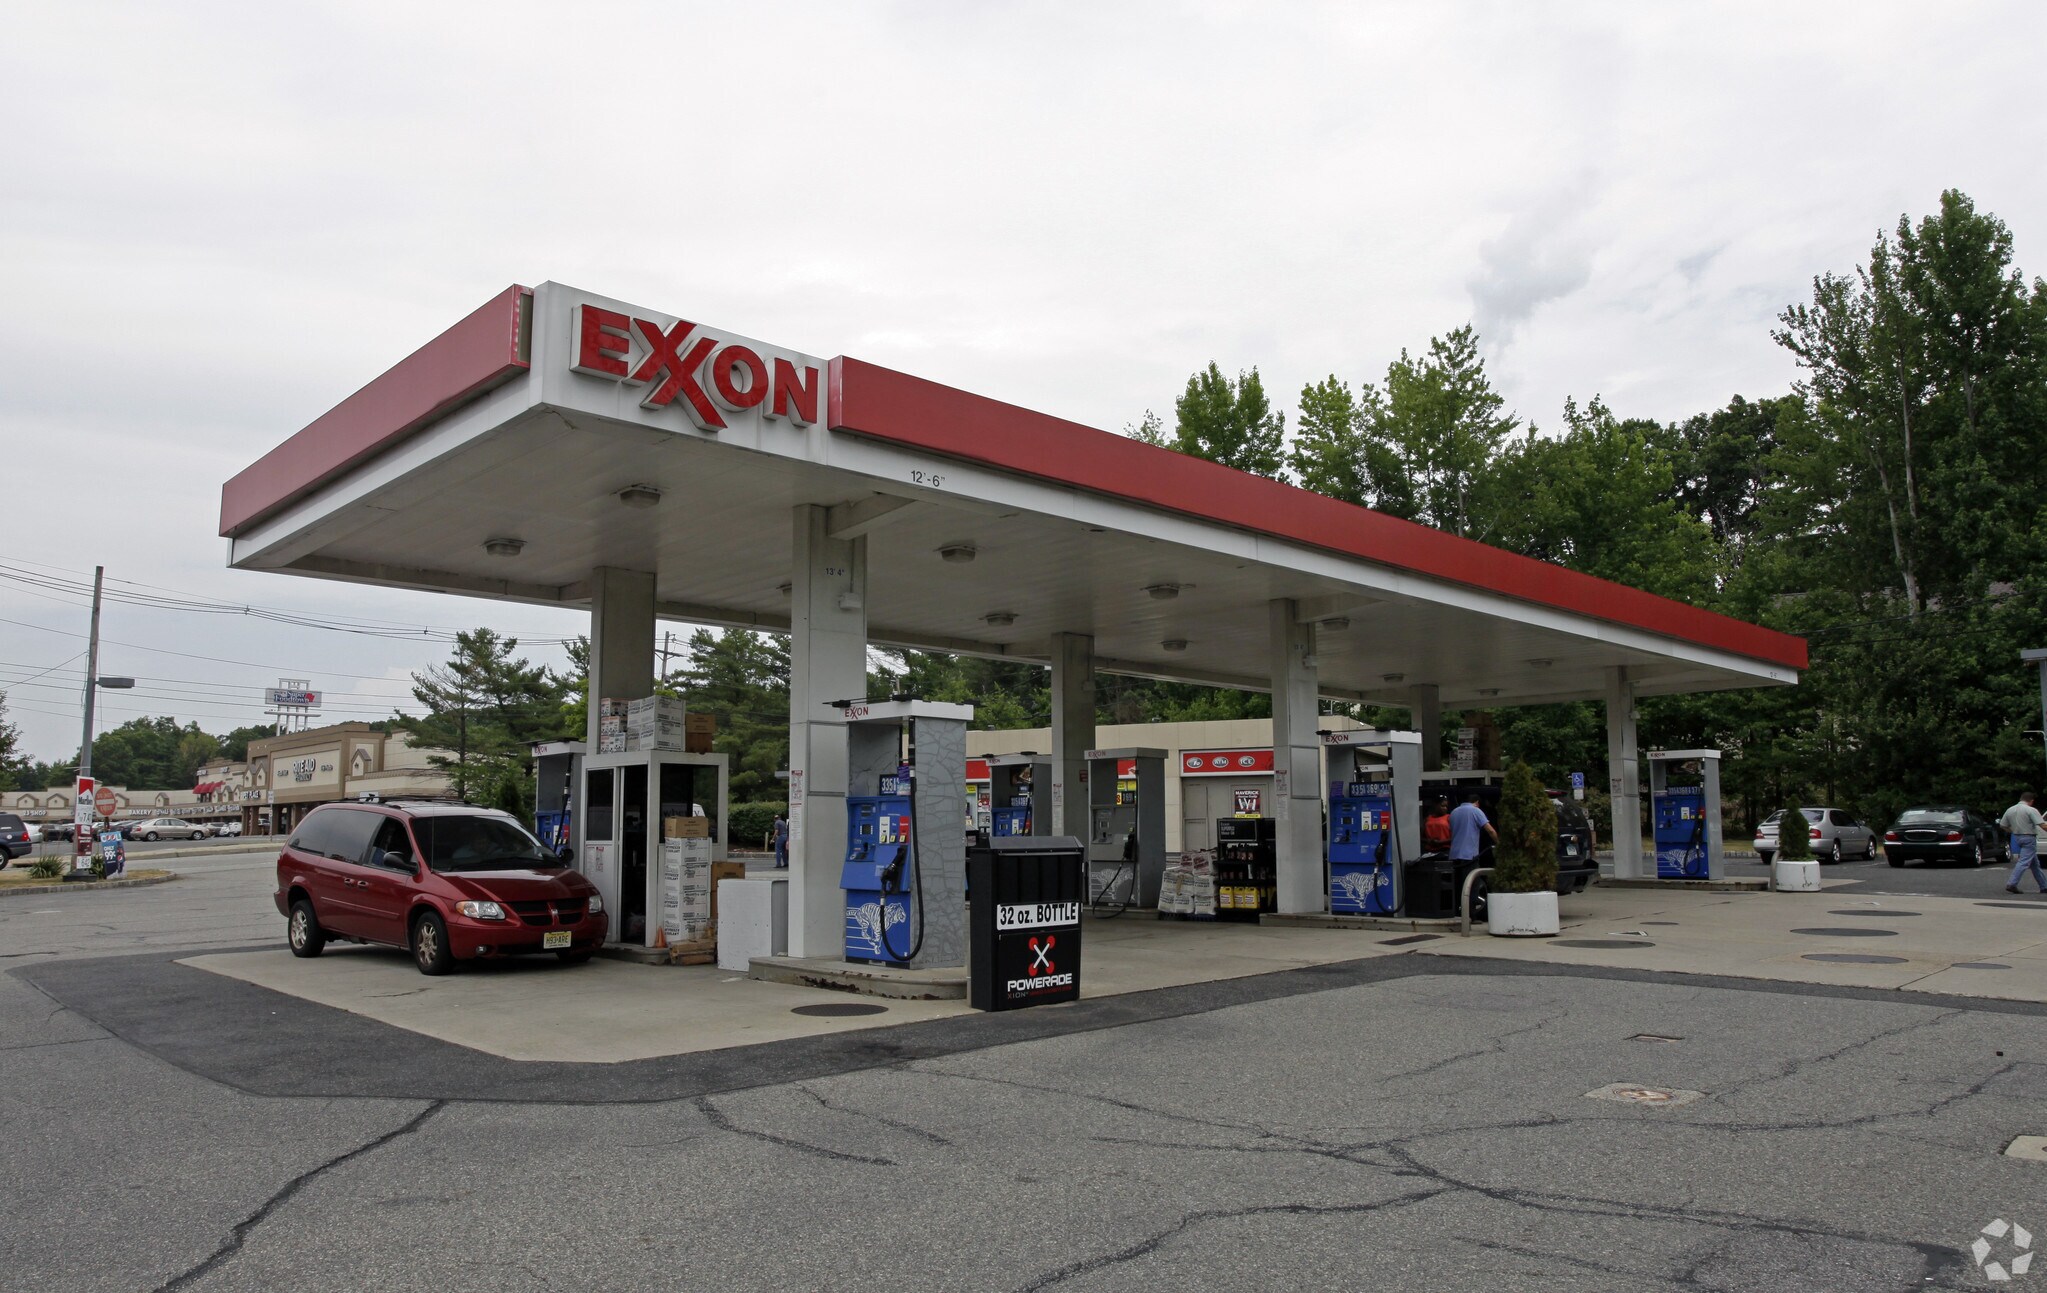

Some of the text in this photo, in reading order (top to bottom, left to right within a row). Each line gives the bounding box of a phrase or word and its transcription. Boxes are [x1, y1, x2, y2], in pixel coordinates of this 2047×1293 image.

[577, 303, 819, 429] EXXON
[844, 706, 869, 719] EXXON
[1325, 734, 1349, 744] EXXON
[1088, 750, 1106, 759] EXXON
[1000, 903, 1077, 925] 32 oz. BOTTLE
[1007, 973, 1072, 992] POWERADE
